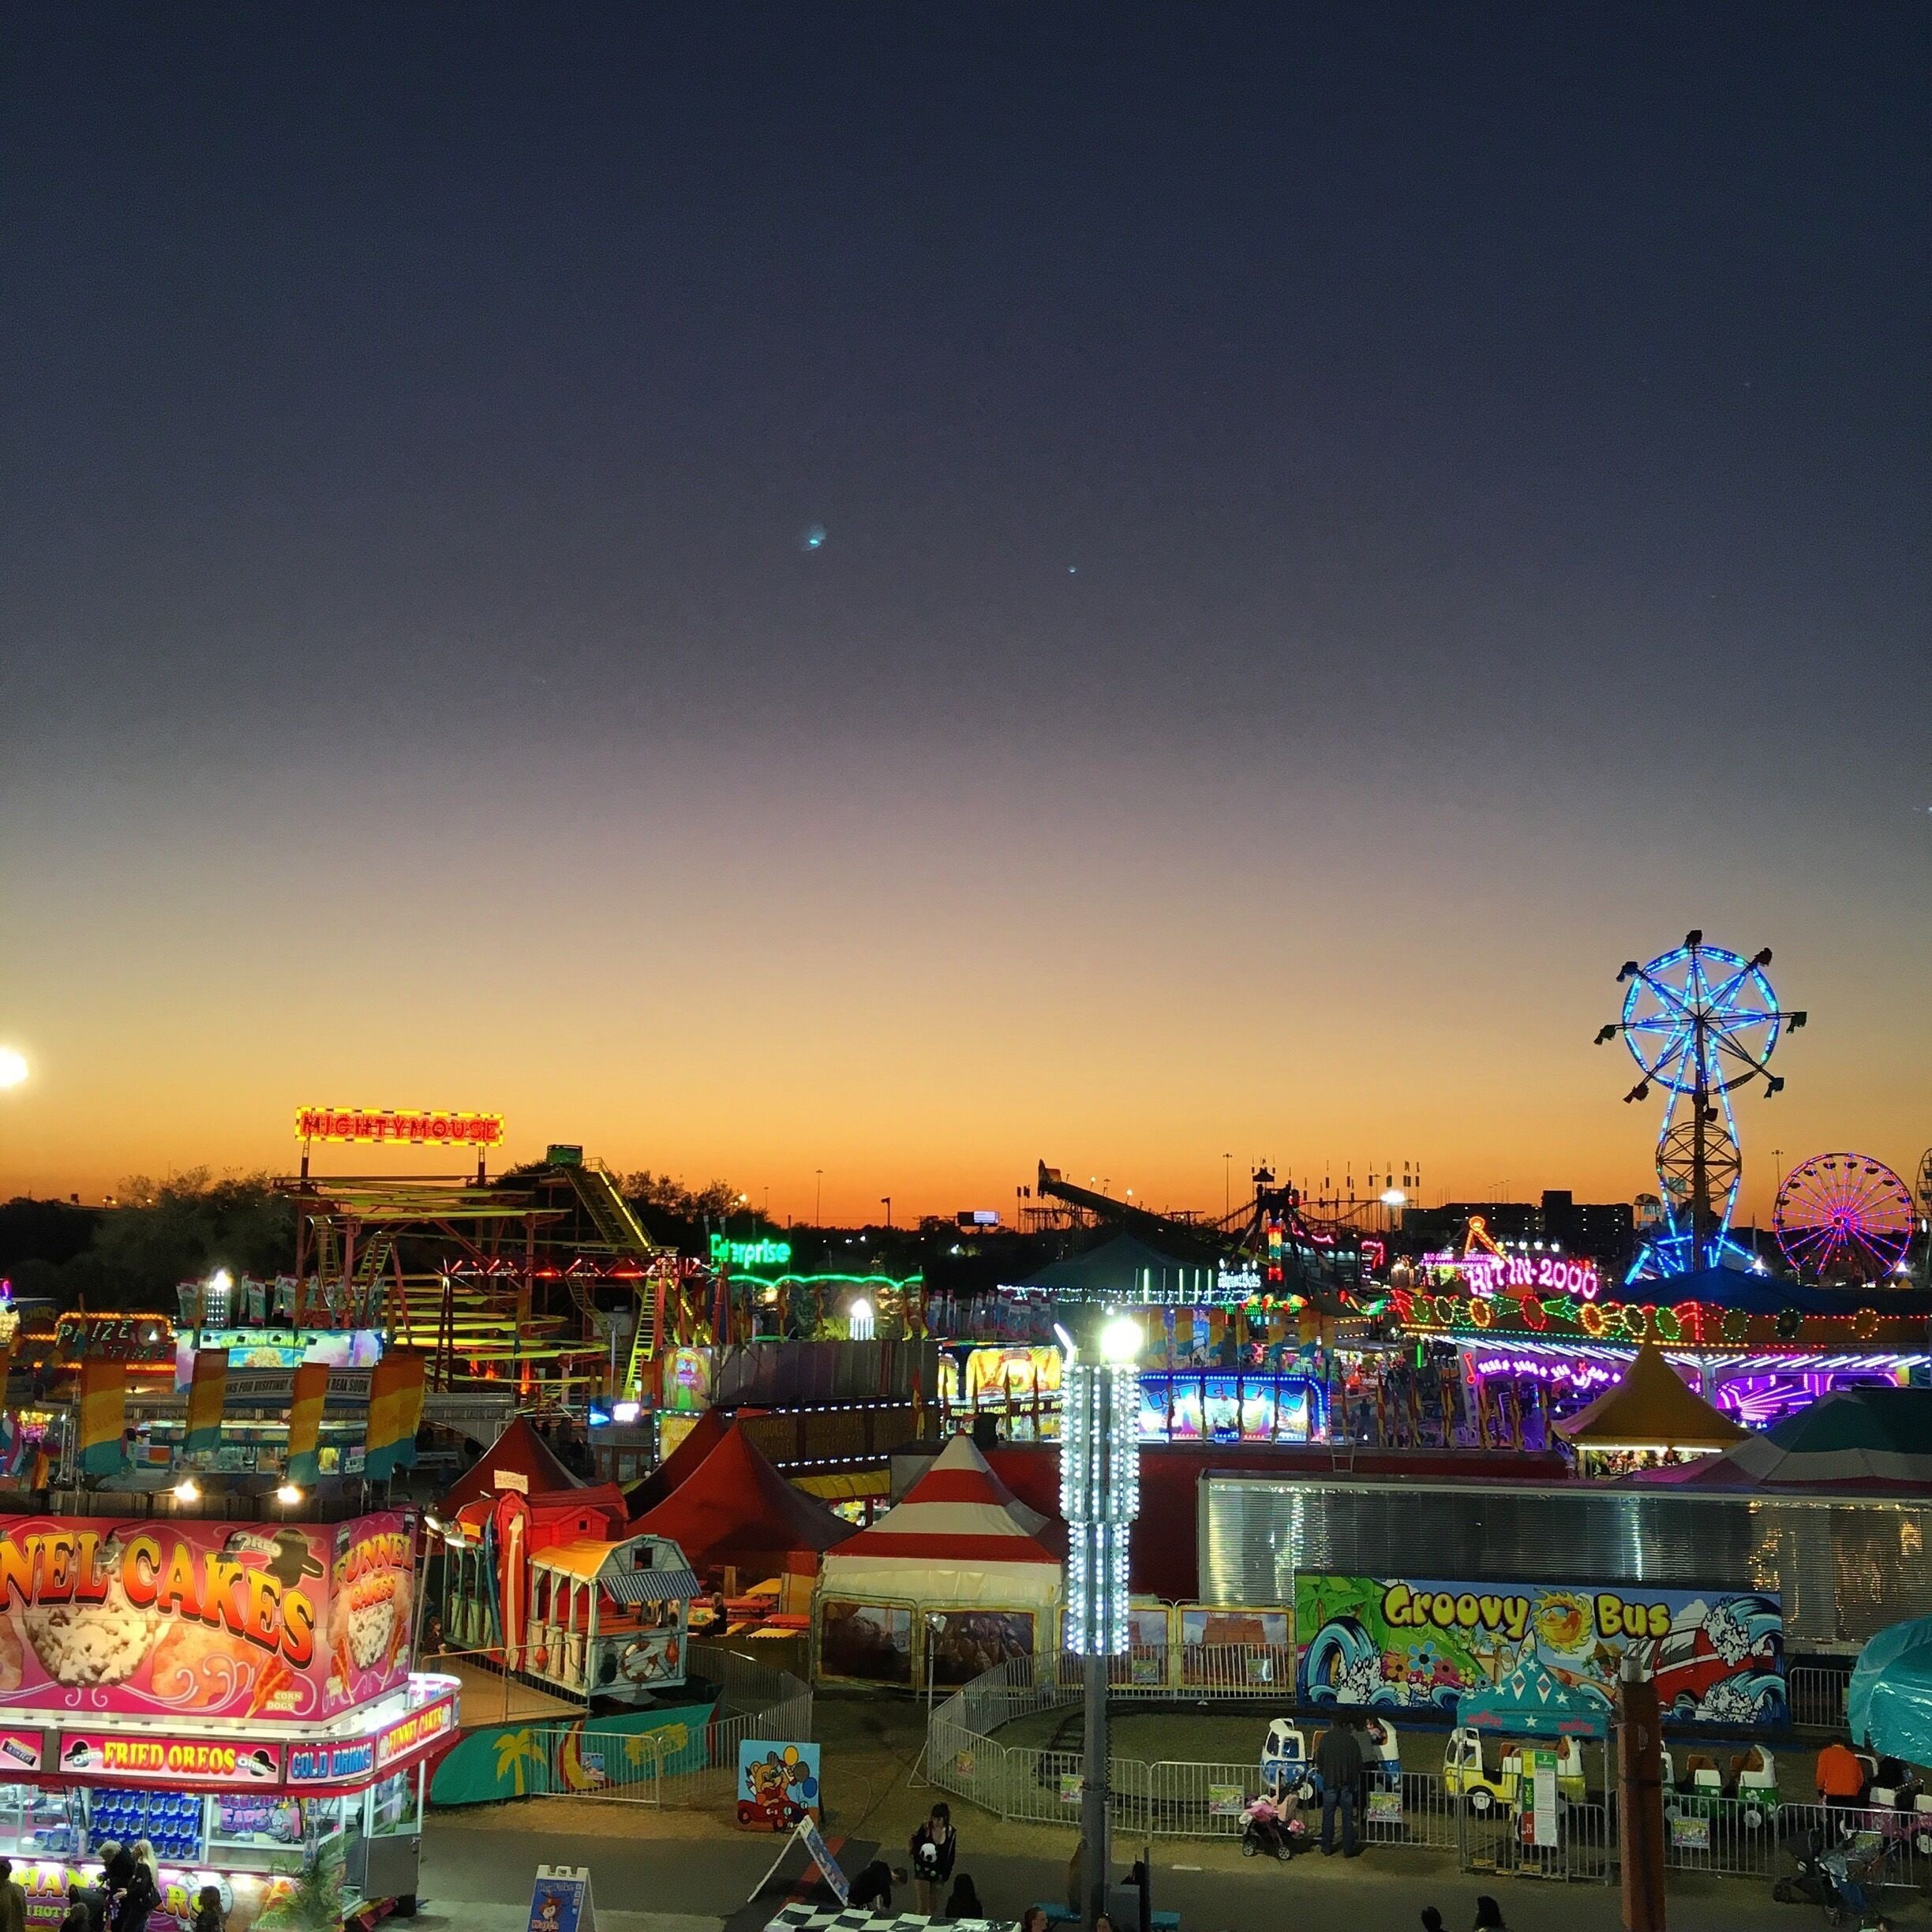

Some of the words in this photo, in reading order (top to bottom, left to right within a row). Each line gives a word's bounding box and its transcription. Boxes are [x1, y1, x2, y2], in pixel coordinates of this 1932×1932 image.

[108, 1345, 169, 1361] TIME
[220, 1333, 268, 1348] COTON
[238, 1381, 254, 1392] FOR
[331, 1378, 349, 1391] REAL
[349, 1379, 369, 1392] SOON
[1148, 1385, 1196, 1410] ICE
[1204, 1382, 1304, 1412] CREAM
[331, 1533, 412, 1601] FUNNEL
[122, 1535, 314, 1669] CAKES
[351, 1574, 395, 1612] CAKES
[1381, 1582, 1531, 1642] Groovy
[1594, 1593, 1672, 1639] Bus
[266, 1701, 296, 1711] DOGS
[274, 1691, 304, 1701] CORN
[388, 1717, 417, 1757] FUNNEL
[418, 1705, 443, 1743] CAKES
[103, 1742, 164, 1771] FRIED
[168, 1745, 236, 1776] OREOS
[291, 1750, 328, 1779] COLD
[331, 1742, 372, 1777] DRINKS
[220, 1807, 270, 1832] EARS
